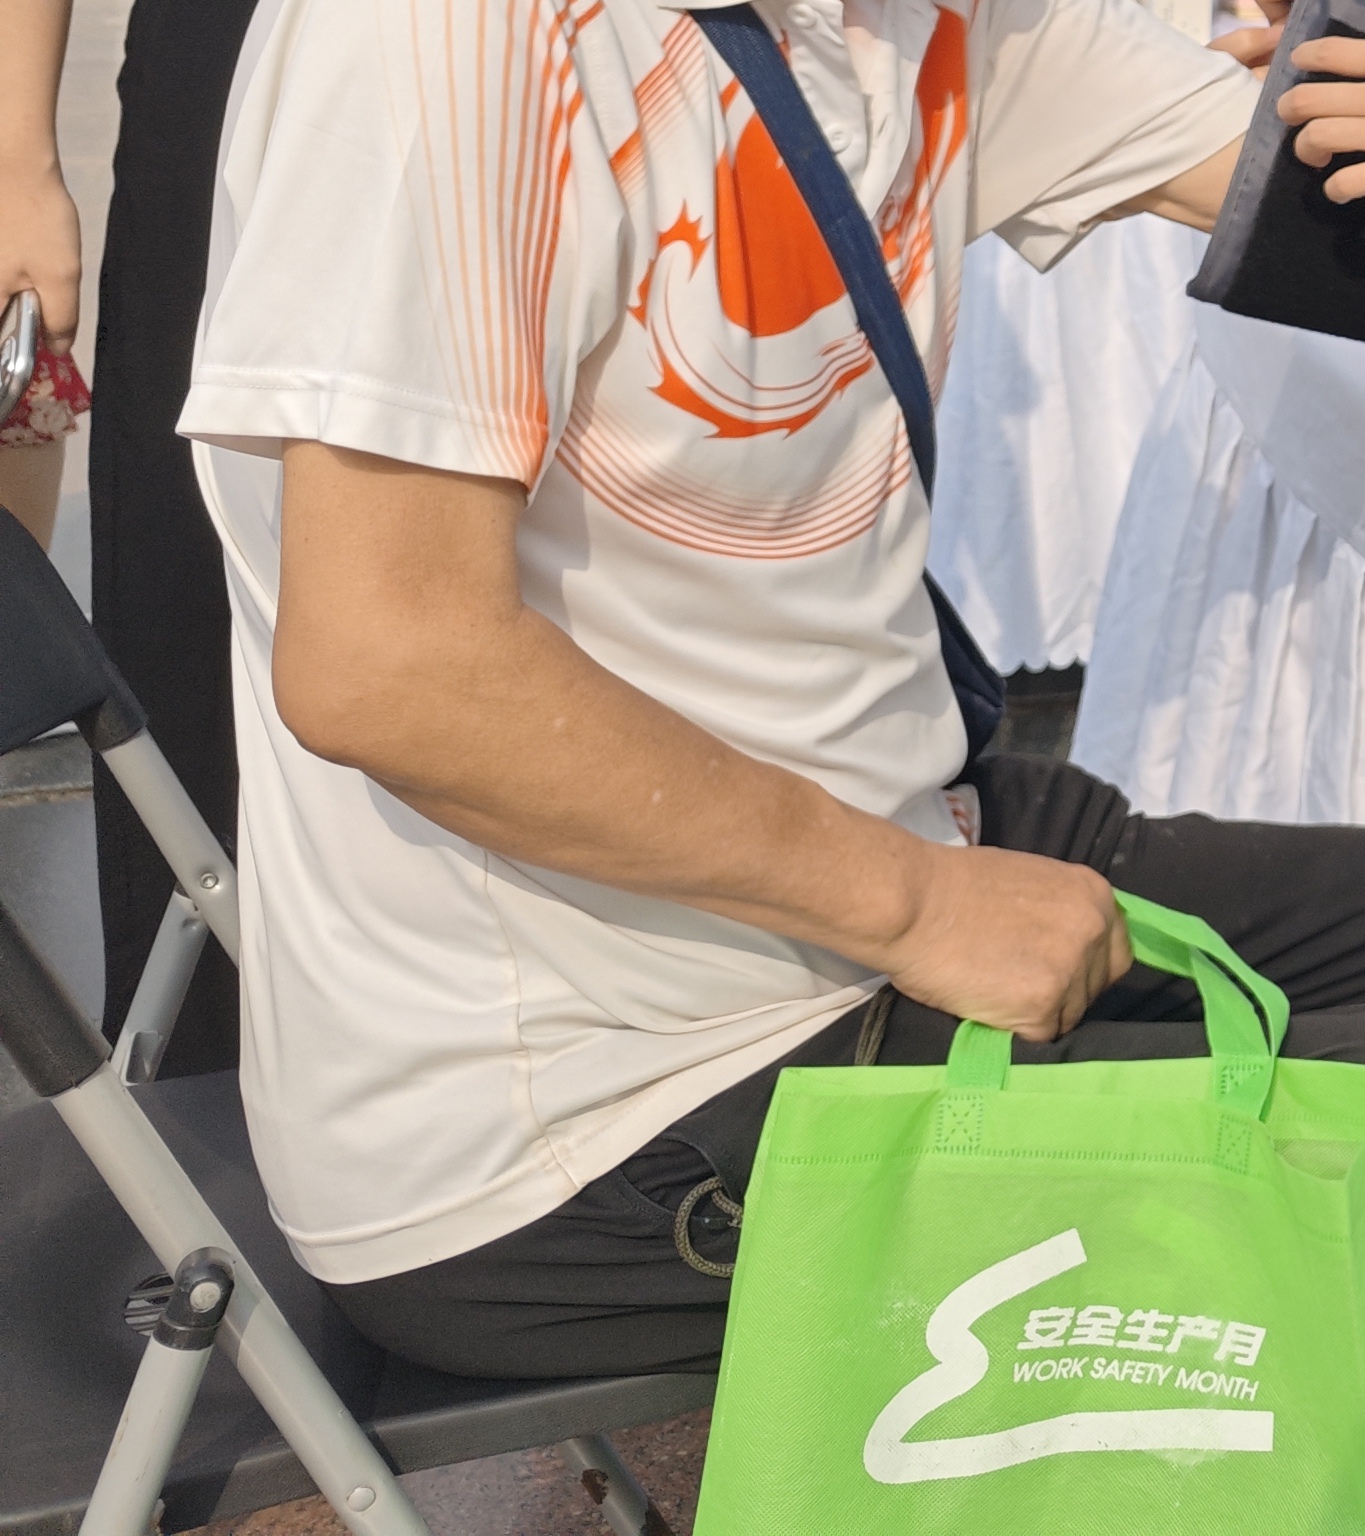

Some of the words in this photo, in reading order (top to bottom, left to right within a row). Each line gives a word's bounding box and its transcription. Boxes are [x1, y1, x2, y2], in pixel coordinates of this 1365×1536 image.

[1016, 1304, 1268, 1367] 安全生产月
[1012, 1356, 1088, 1384] WORK
[1089, 1356, 1174, 1388] SAFETY
[1175, 1368, 1260, 1402] MONTH
